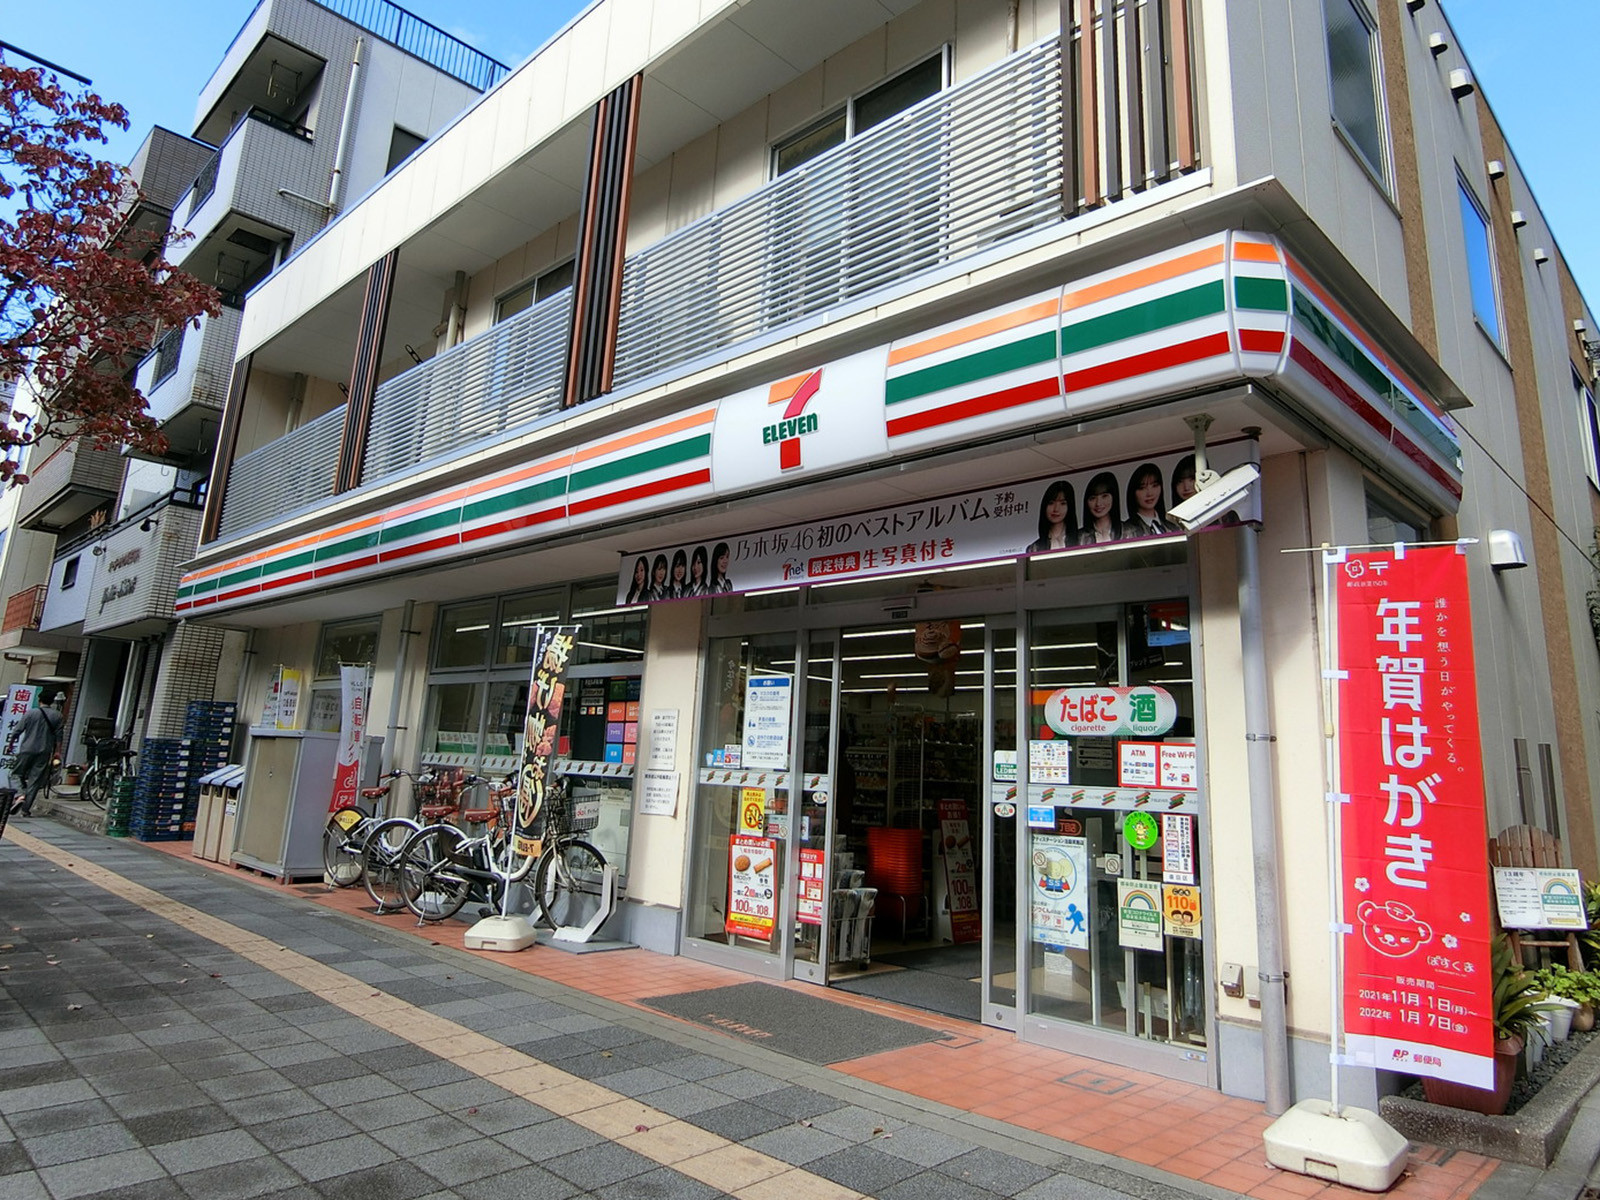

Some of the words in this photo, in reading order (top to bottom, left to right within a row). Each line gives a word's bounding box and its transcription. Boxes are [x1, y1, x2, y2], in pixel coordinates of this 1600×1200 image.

[994, 491, 1014, 506] 予約
[735, 498, 991, 560] 乃木坂46初のベストアルバム
[863, 538, 955, 570] 生写真付き
[811, 556, 856, 575] 限定特典
[1434, 597, 1465, 773] 誰かを想う日がやってくる。
[11, 689, 31, 716] 歯科
[1060, 694, 1117, 723] たばこ
[1129, 694, 1156, 722] 酒
[1071, 724, 1106, 732] cigarette
[1132, 724, 1158, 732] liquor
[1375, 597, 1442, 889] 年賀はがき
[1131, 749, 1146, 757] ATM
[1177, 751, 1195, 759] Wi-Fi
[1396, 975, 1435, 990] 販売期間
[1359, 1006, 1392, 1019] 2022年
[1413, 1054, 1442, 1067] 郵便局
